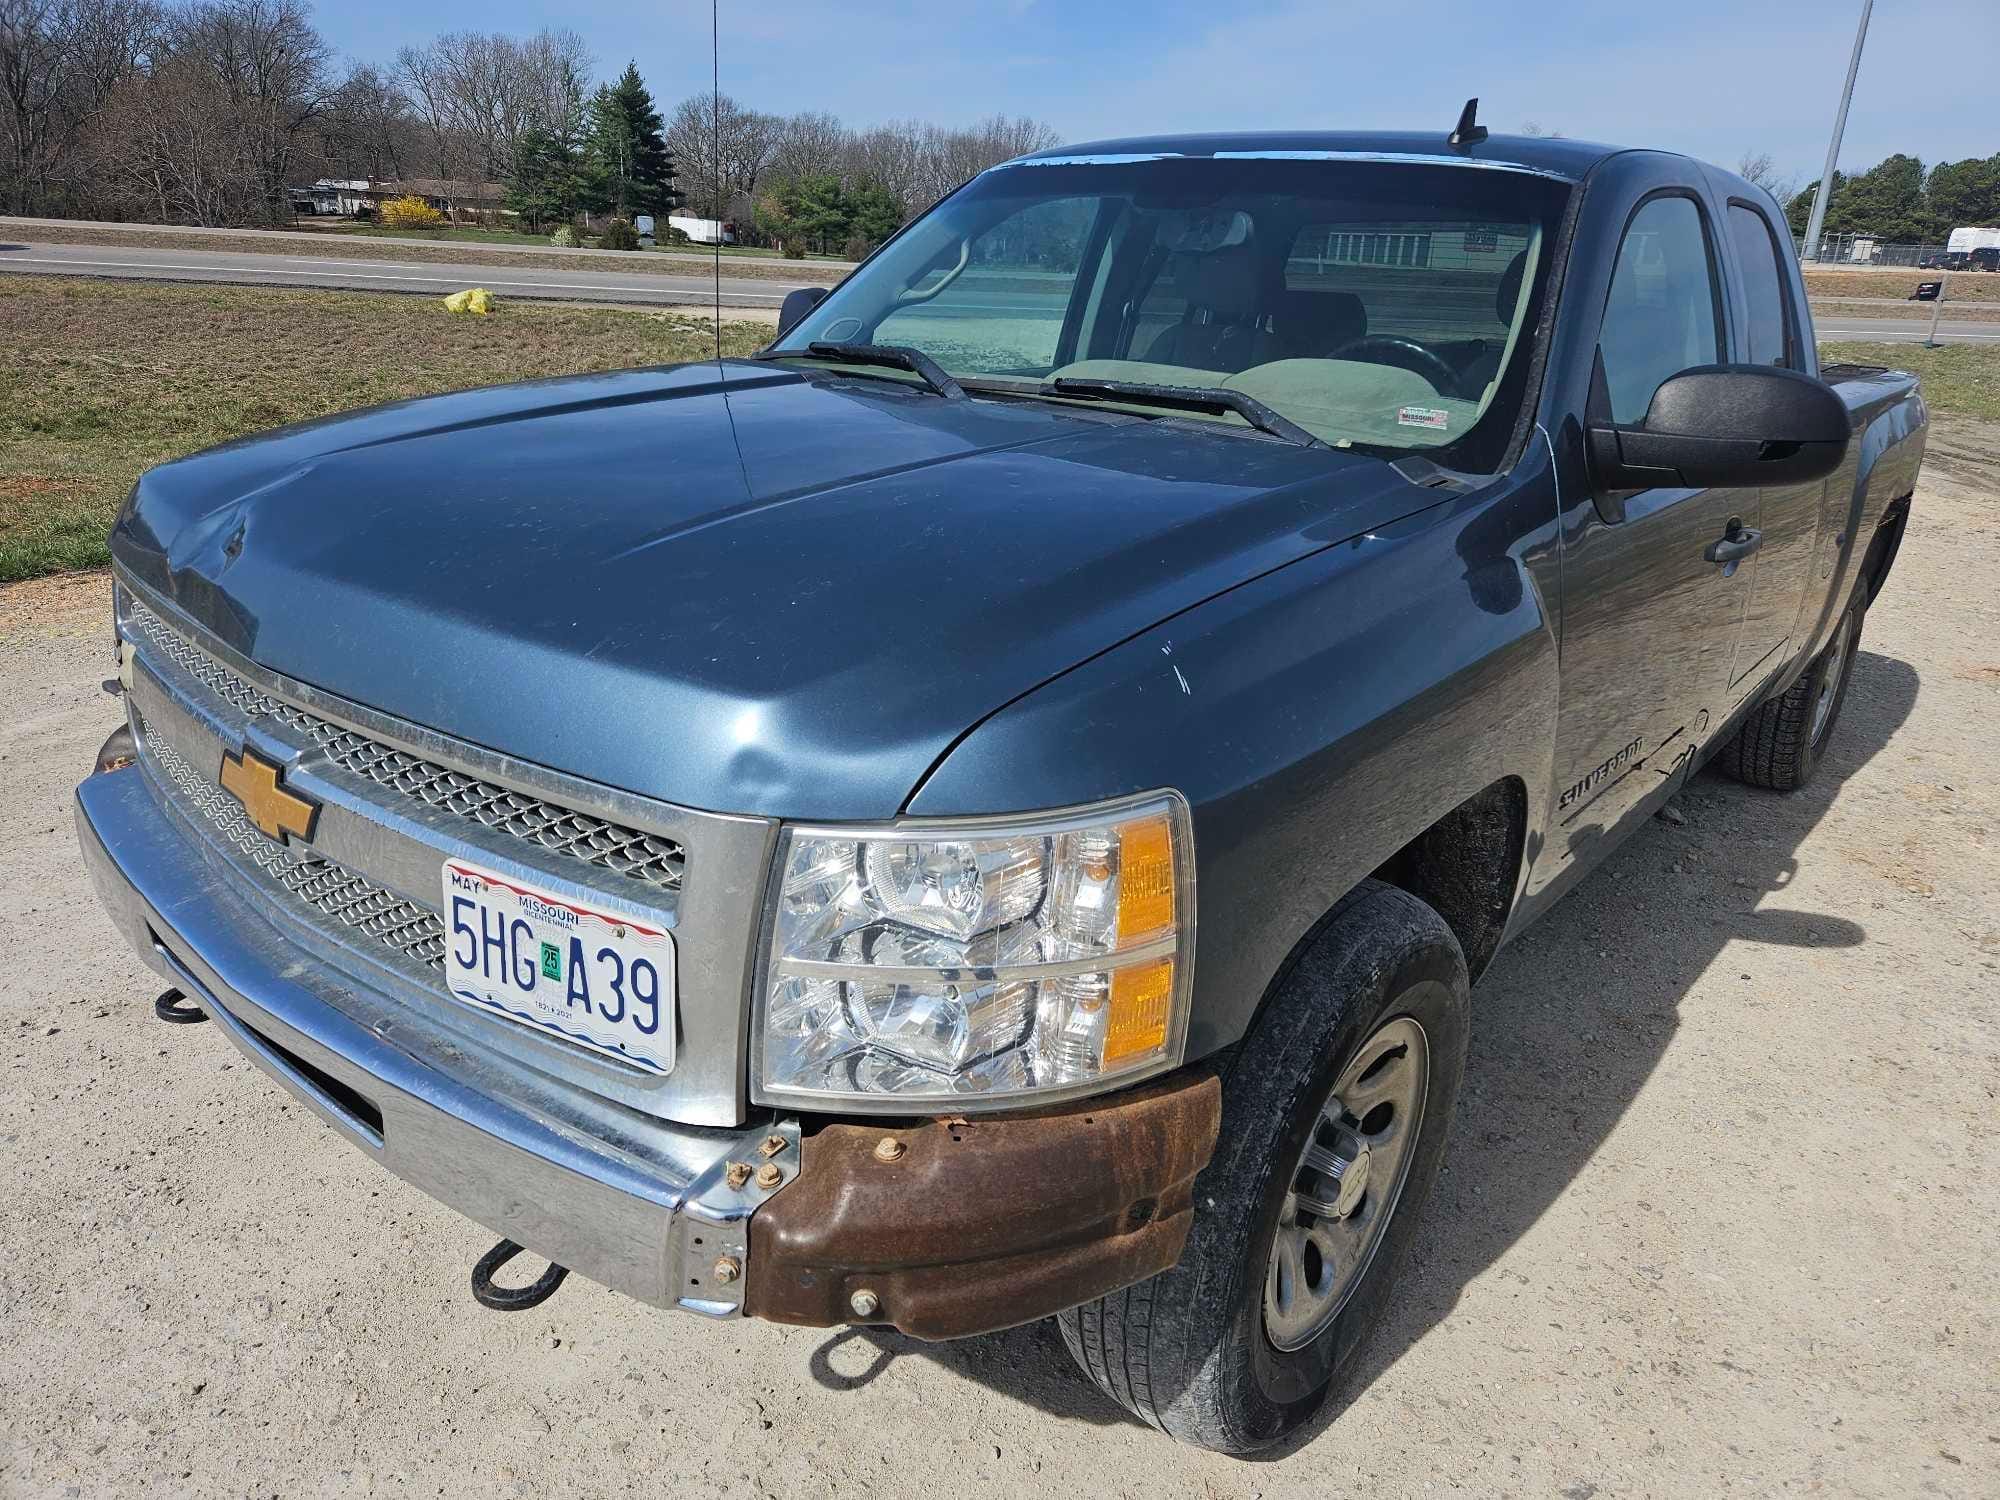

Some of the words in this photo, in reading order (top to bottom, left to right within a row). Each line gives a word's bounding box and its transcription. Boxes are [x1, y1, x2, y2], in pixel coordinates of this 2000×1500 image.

[451, 872, 481, 894] MAY
[519, 896, 579, 925] MISSOURI
[523, 909, 574, 931] BICENTENNIAL
[452, 895, 536, 992] 5HG
[566, 936, 659, 1035] A39
[544, 949, 558, 969] 25
[556, 1008, 572, 1019] 2021
